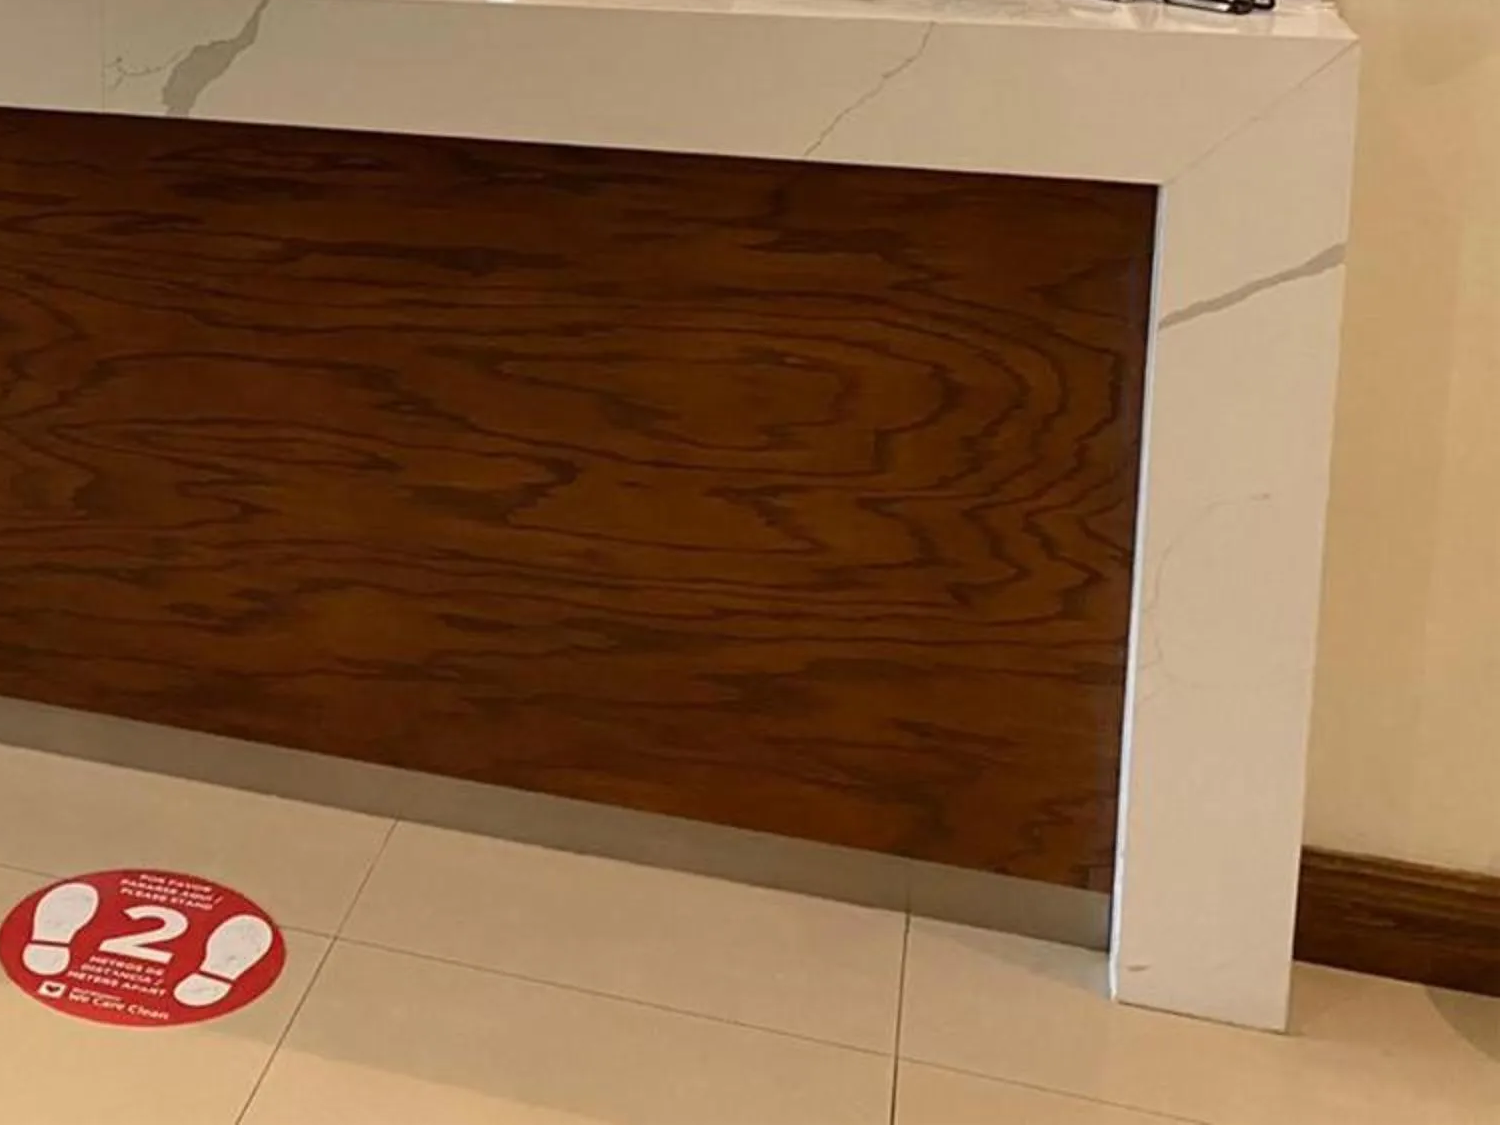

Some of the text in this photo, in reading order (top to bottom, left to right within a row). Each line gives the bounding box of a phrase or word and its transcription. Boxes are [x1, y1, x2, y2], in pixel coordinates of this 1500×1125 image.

[120, 887, 213, 911] PLEASE STAND
[99, 905, 189, 964] 2
[80, 962, 152, 984] DISTANCIA
[89, 955, 165, 977] METROS DE
[67, 969, 119, 988] METERS
[120, 981, 167, 997] APART
[91, 997, 126, 1012] Care
[127, 1004, 169, 1020] Clean
